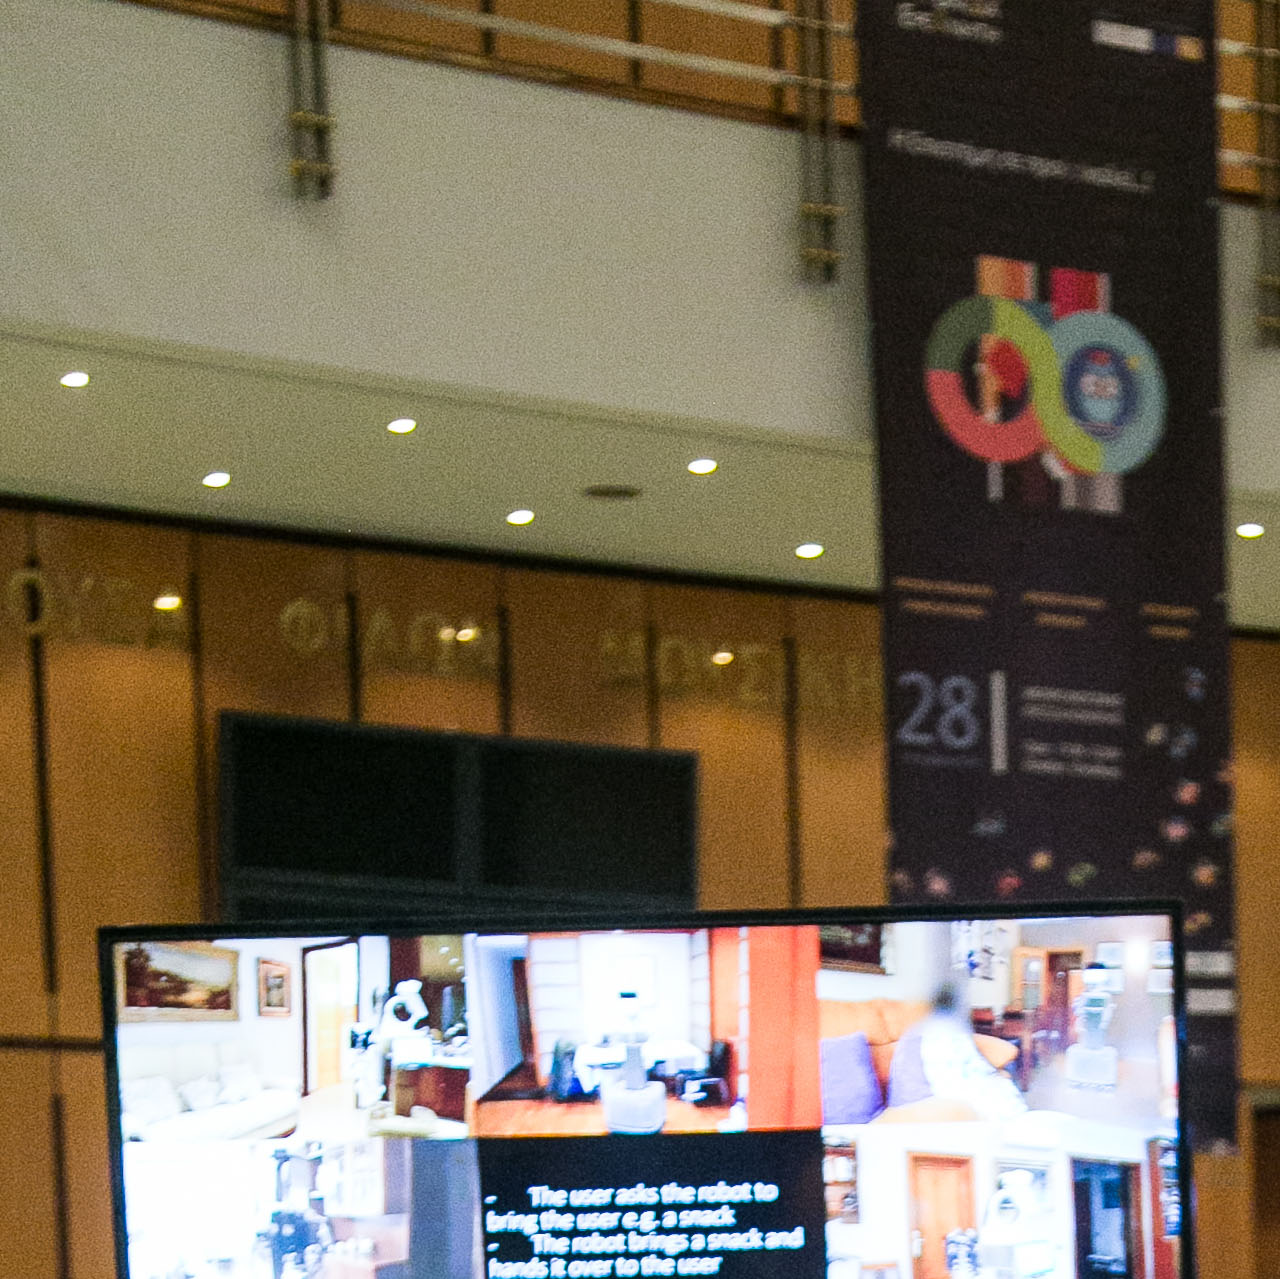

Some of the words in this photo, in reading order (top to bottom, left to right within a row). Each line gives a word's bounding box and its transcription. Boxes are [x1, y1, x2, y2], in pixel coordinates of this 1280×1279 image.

[897, 670, 980, 750] 28
[526, 1185, 568, 1207] The
[569, 1188, 614, 1207] user
[614, 1183, 660, 1206] asks
[660, 1182, 696, 1204] the
[697, 1181, 752, 1203] robot
[753, 1182, 779, 1202] to
[486, 1210, 539, 1235] bring
[539, 1209, 575, 1231] the
[576, 1212, 622, 1230] user
[662, 1211, 677, 1228] a
[678, 1205, 737, 1227] snack
[530, 1233, 570, 1255] The
[571, 1232, 627, 1254] robot
[628, 1231, 689, 1256] brings
[690, 1234, 706, 1251] a
[707, 1228, 764, 1250] snack
[764, 1226, 804, 1249] and
[488, 1257, 549, 1279] hands
[550, 1257, 567, 1278] it
[567, 1260, 614, 1278] over
[615, 1257, 640, 1277] to
[640, 1254, 676, 1276] the
[677, 1256, 723, 1275] user
